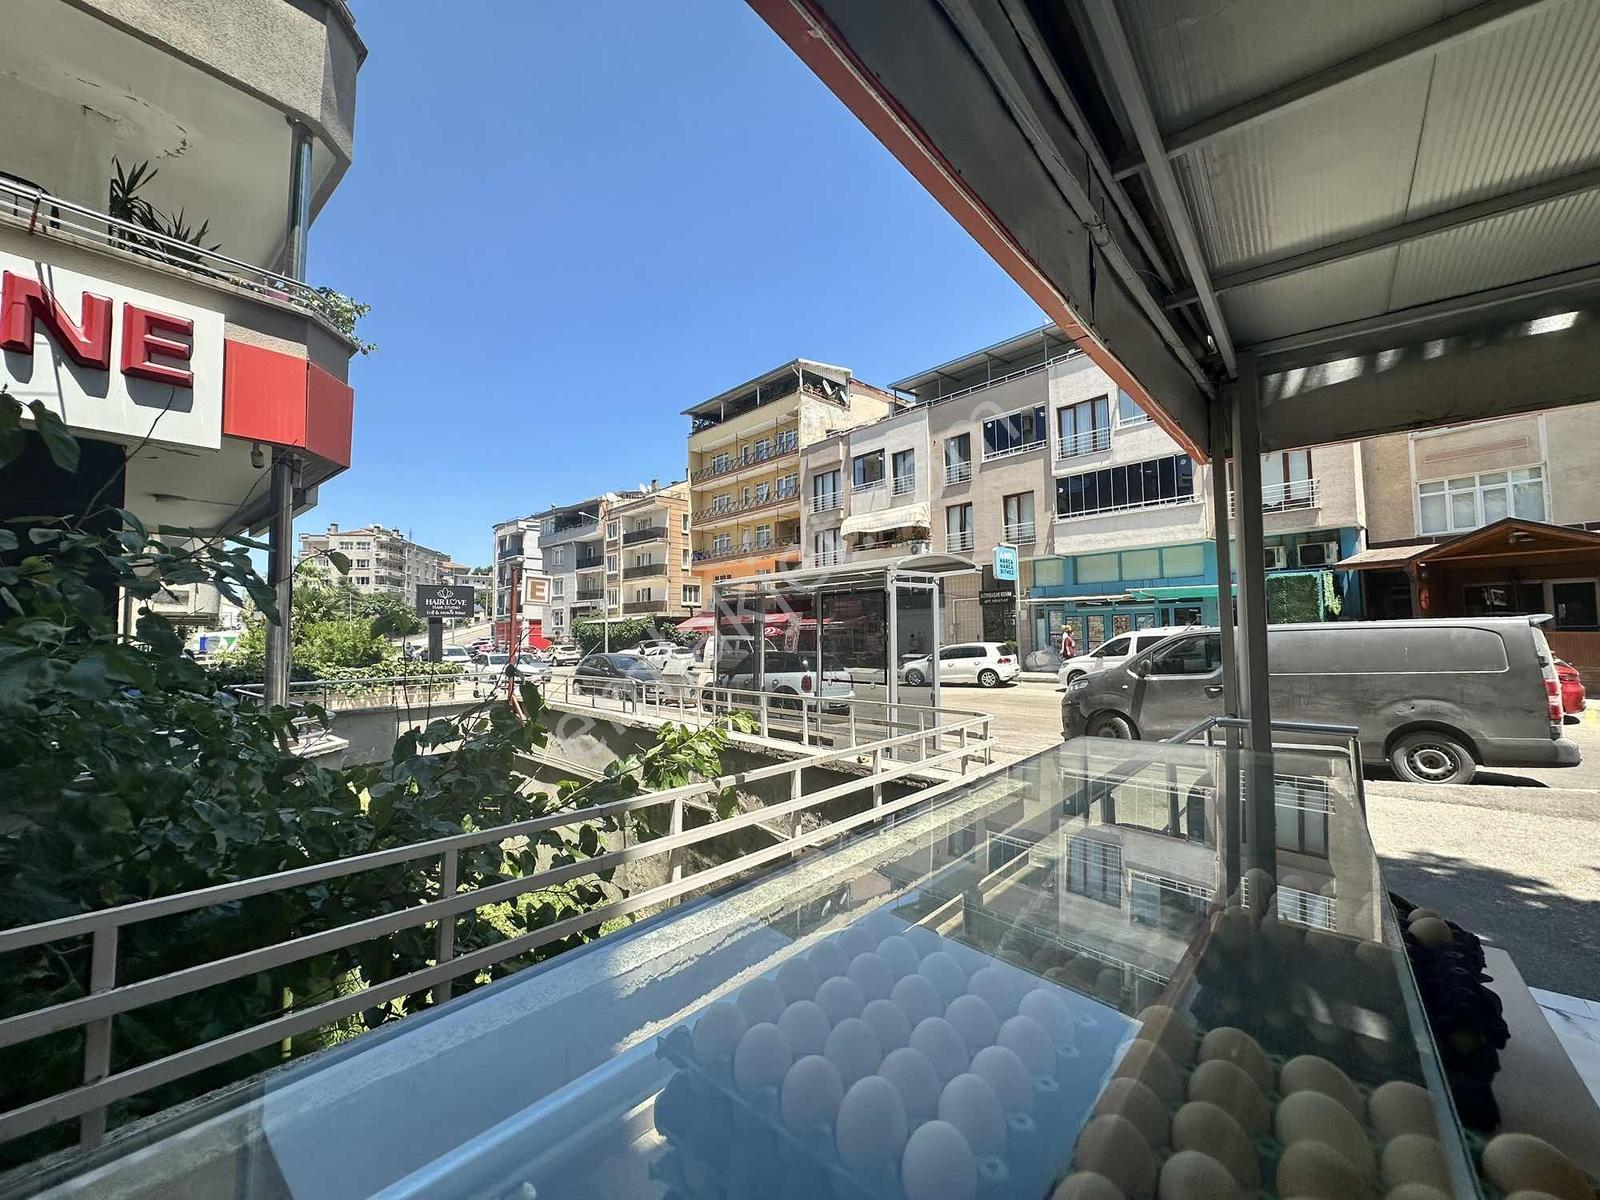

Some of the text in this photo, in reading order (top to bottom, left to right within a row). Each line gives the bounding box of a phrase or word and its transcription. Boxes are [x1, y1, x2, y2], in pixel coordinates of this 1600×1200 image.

[0, 270, 194, 388] NE
[531, 581, 545, 600] E
[425, 598, 445, 606] HAIR
